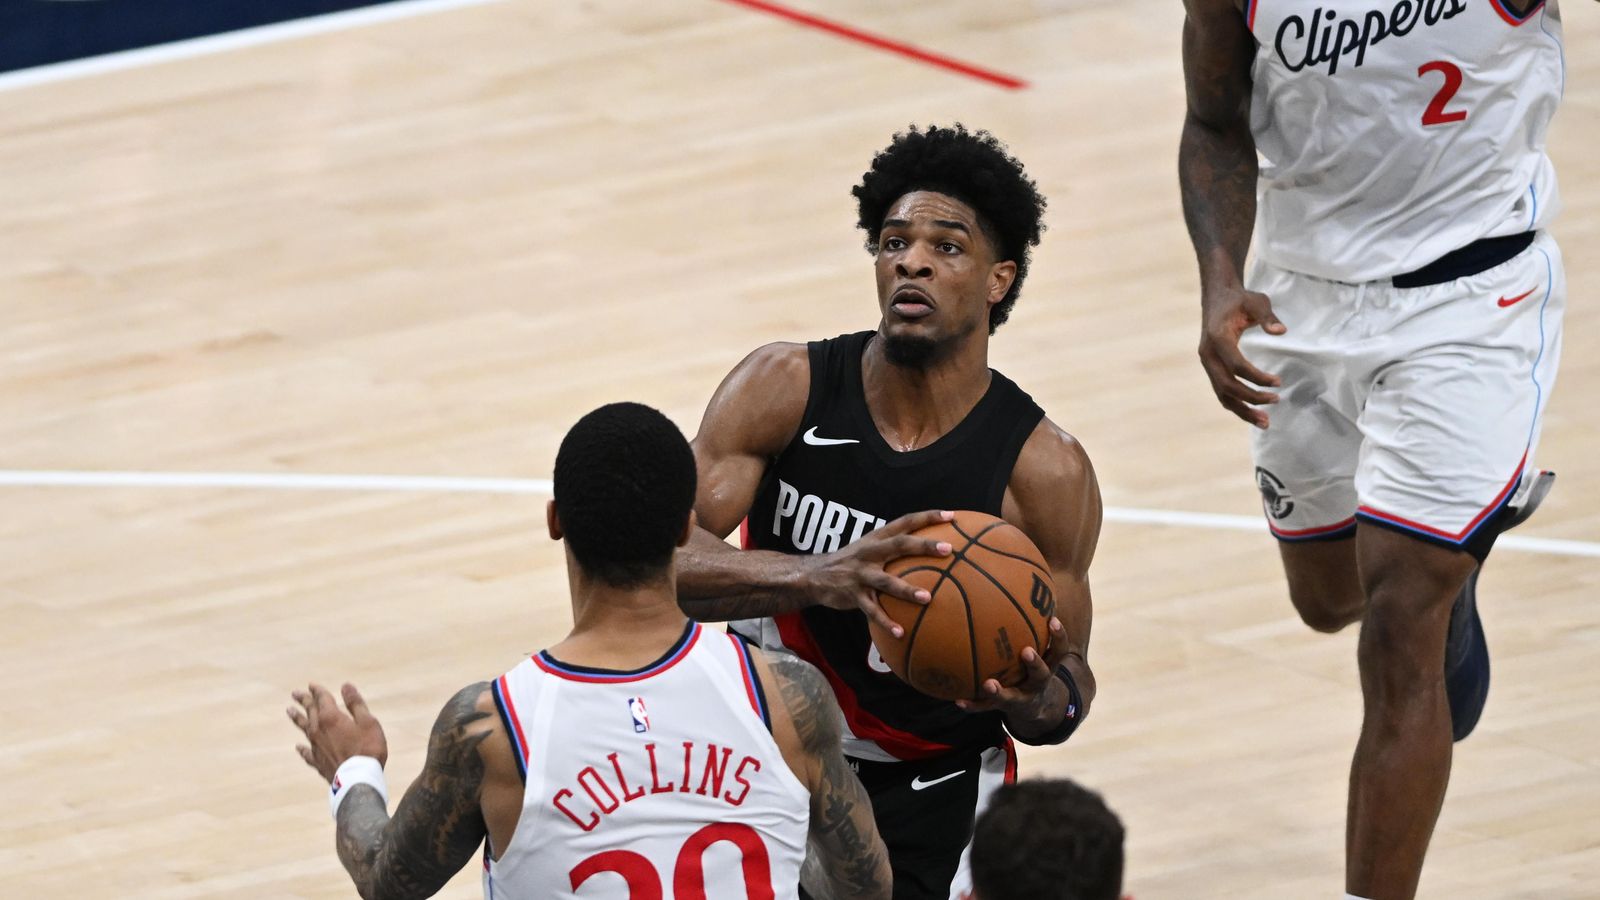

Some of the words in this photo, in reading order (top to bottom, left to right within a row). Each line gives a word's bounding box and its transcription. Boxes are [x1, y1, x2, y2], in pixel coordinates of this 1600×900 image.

[1417, 61, 1468, 127] 2
[772, 478, 887, 555] PORT
[553, 742, 761, 832] COLLINS
